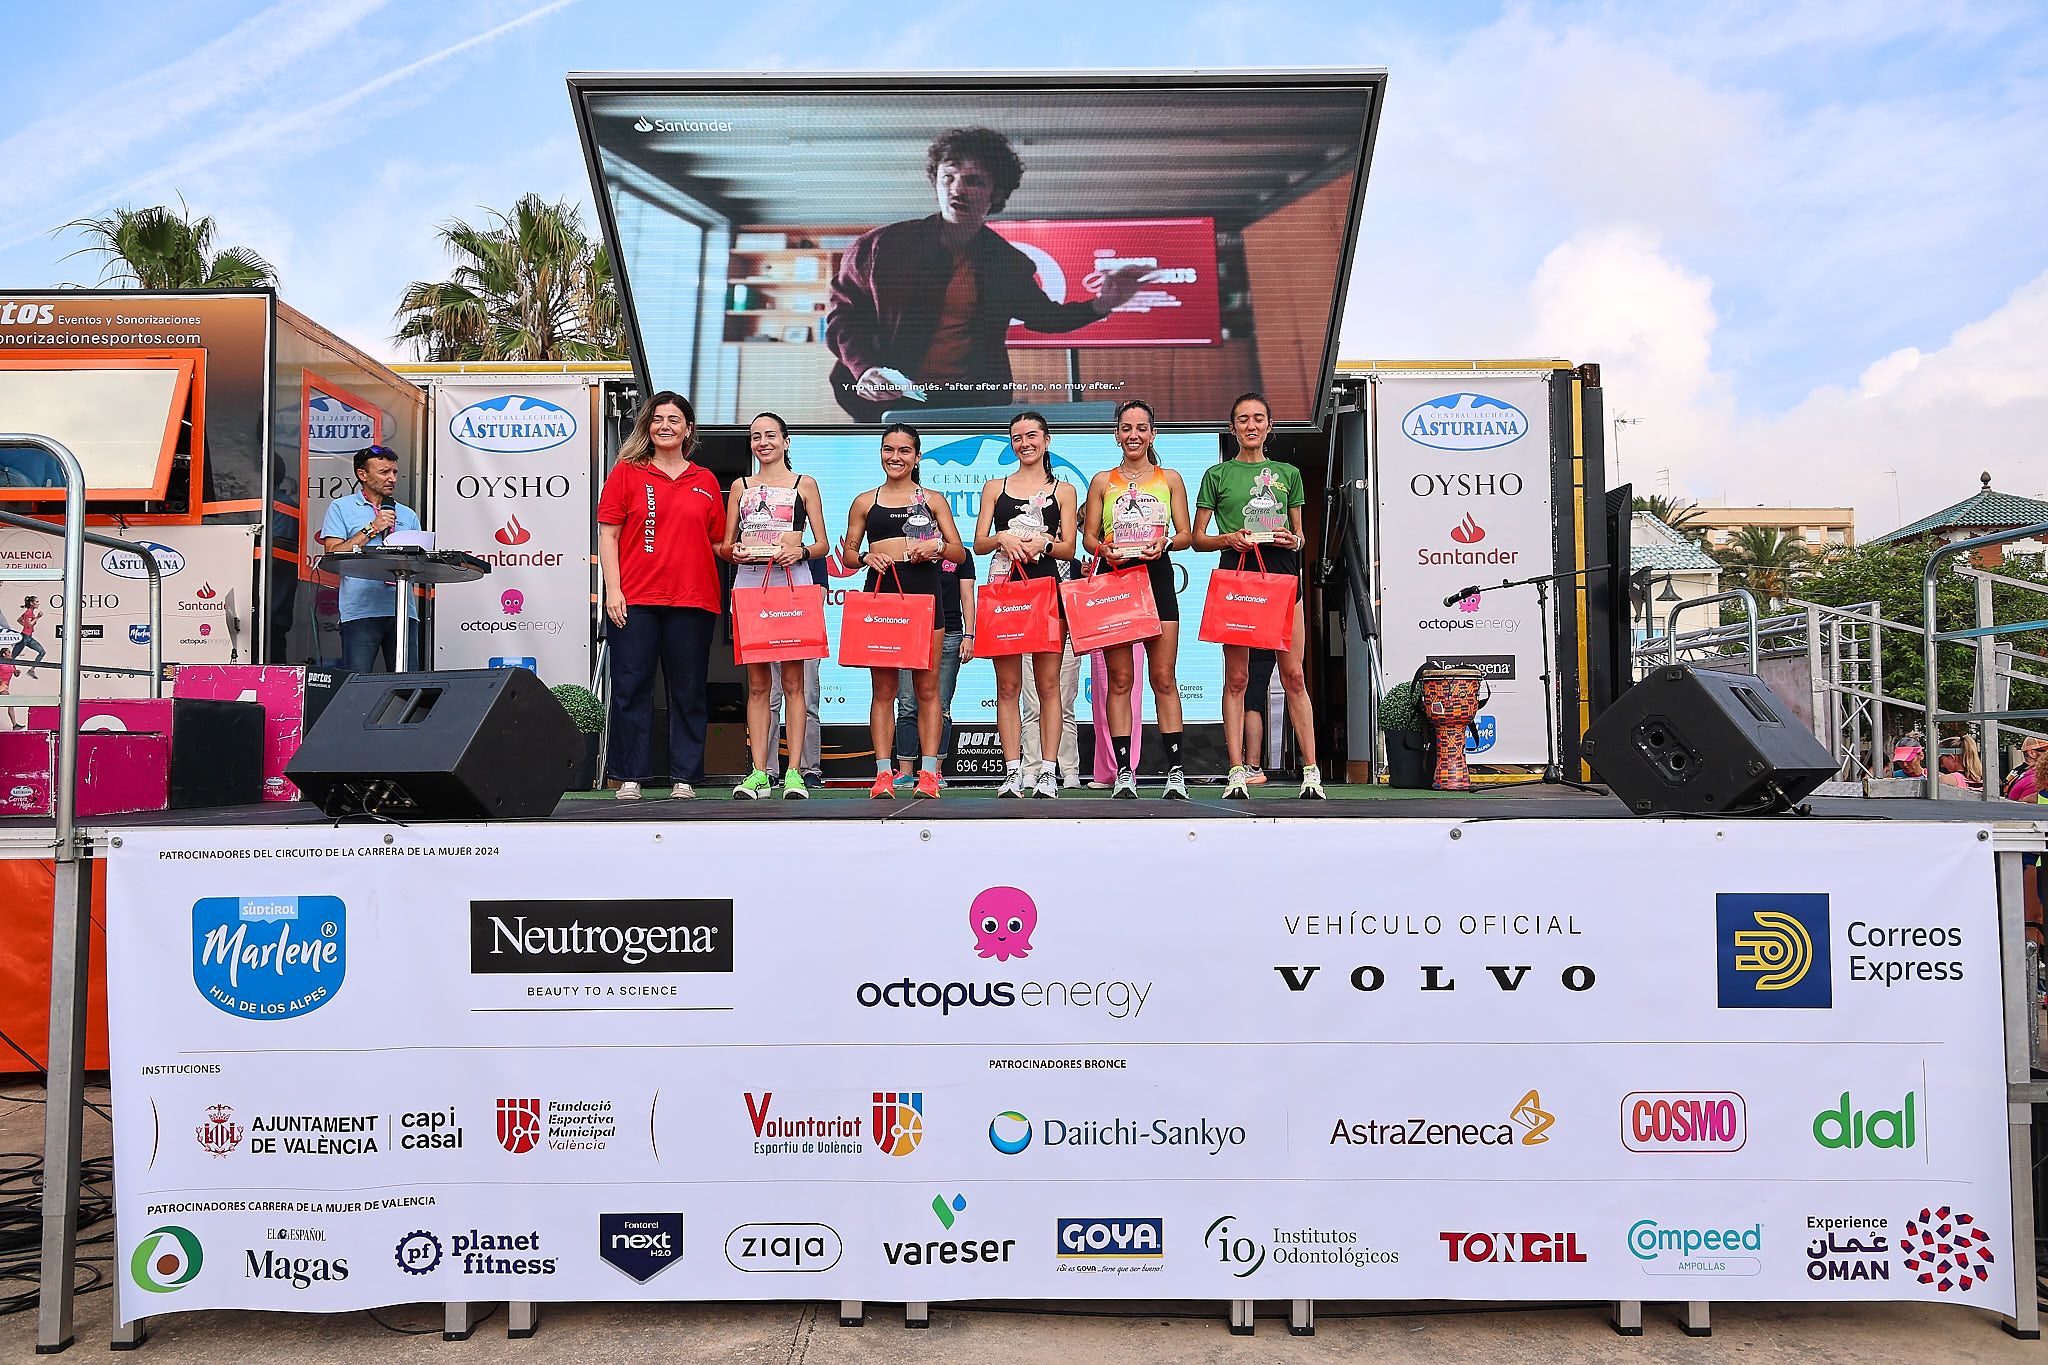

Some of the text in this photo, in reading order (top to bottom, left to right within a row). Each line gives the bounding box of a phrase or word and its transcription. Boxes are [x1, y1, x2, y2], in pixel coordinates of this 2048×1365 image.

[655, 120, 733, 132] Santander
[0, 301, 201, 326] tos Eventos y Sonorizaciones
[866, 383, 907, 391] hablaba
[976, 383, 1000, 391] after
[1002, 383, 1029, 392] after,
[1031, 384, 1046, 392] no,
[1065, 384, 1086, 392] muy
[458, 416, 568, 438] ASTURIANA
[1411, 414, 1520, 436] ASTURIANA
[456, 475, 570, 499] OYSHO
[1410, 473, 1523, 496] OYSHO
[0, 551, 52, 559] VALENCIA
[107, 555, 179, 570] ASTUANA
[464, 551, 563, 567] ntander
[1418, 548, 1519, 565] Santander
[49, 594, 119, 608] OSHO
[178, 601, 226, 611] Santand
[1094, 592, 1131, 605] Santander
[1233, 594, 1268, 604] Santander
[769, 610, 804, 618] Santander
[1001, 604, 1032, 613] Santander
[461, 620, 565, 634] octopus energy
[873, 616, 910, 624] Santander
[1418, 618, 1521, 632] octopus energy
[1180, 692, 1203, 700] Express
[957, 732, 1001, 748] port
[956, 759, 1003, 772] 696 455
[159, 846, 500, 860] PATROCINADORES DEL CIRCUITO DE LA CARRERA DE LA MUJER 2024
[1284, 910, 1582, 935] VEHÍCULO OFICIAL
[487, 916, 716, 964] Neutrogena
[1847, 921, 1962, 947] Correos
[202, 922, 338, 988] Marlene
[1273, 965, 1597, 991] VOLVO
[1849, 955, 1964, 987] Express
[209, 985, 328, 1014] HIJA DE LOS ALPES
[527, 986, 678, 996] BEAUTY TO A SCIENCE
[856, 977, 1153, 1018] octopus energy
[141, 1064, 221, 1075] INSTITUCIONES
[989, 1059, 1127, 1069] PATROCINADORES BRONCE
[548, 1100, 612, 1111] Fundació
[251, 1115, 379, 1132] AJUNTAMENT
[401, 1106, 455, 1132] cap i
[548, 1114, 614, 1127] Esportiva
[743, 1092, 862, 1138] Voluntariat
[1632, 1099, 1737, 1142] COSMO
[1812, 1091, 1916, 1149] dial
[401, 1128, 463, 1149] casal
[548, 1126, 616, 1139] Municipal
[1043, 1118, 1246, 1156] Daiichi-Sankyo
[1329, 1118, 1514, 1146] AstraZeneca
[251, 1134, 378, 1154] DE VALÈNCIA
[548, 1139, 606, 1151] València
[754, 1140, 862, 1156] Esportiu de València
[147, 1196, 436, 1215] PATROCINADORES CARRERA DE LA MUJER DE VALENCIA
[624, 1221, 659, 1229] Fontarel
[1807, 1215, 1888, 1231] Experience
[267, 1227, 326, 1242] EL ESPAÑOL
[452, 1229, 539, 1256] planet
[612, 1231, 671, 1249] next
[1062, 1222, 1158, 1253] GOYA
[1273, 1227, 1358, 1244] Institutos
[1627, 1219, 1761, 1260] Compeed
[407, 1243, 431, 1263] pf
[741, 1237, 824, 1266] ziaja
[883, 1239, 1016, 1265] vareser
[1219, 1226, 1256, 1263] io
[463, 1253, 556, 1275] fitness
[1273, 1247, 1400, 1267] Odontológicos
[245, 1249, 349, 1289] Magas
[1076, 1265, 1096, 1273] GOYA
[1116, 1265, 1128, 1276] que
[1678, 1261, 1726, 1271] AMPOLLAS
[1806, 1260, 1889, 1281] OMAN
